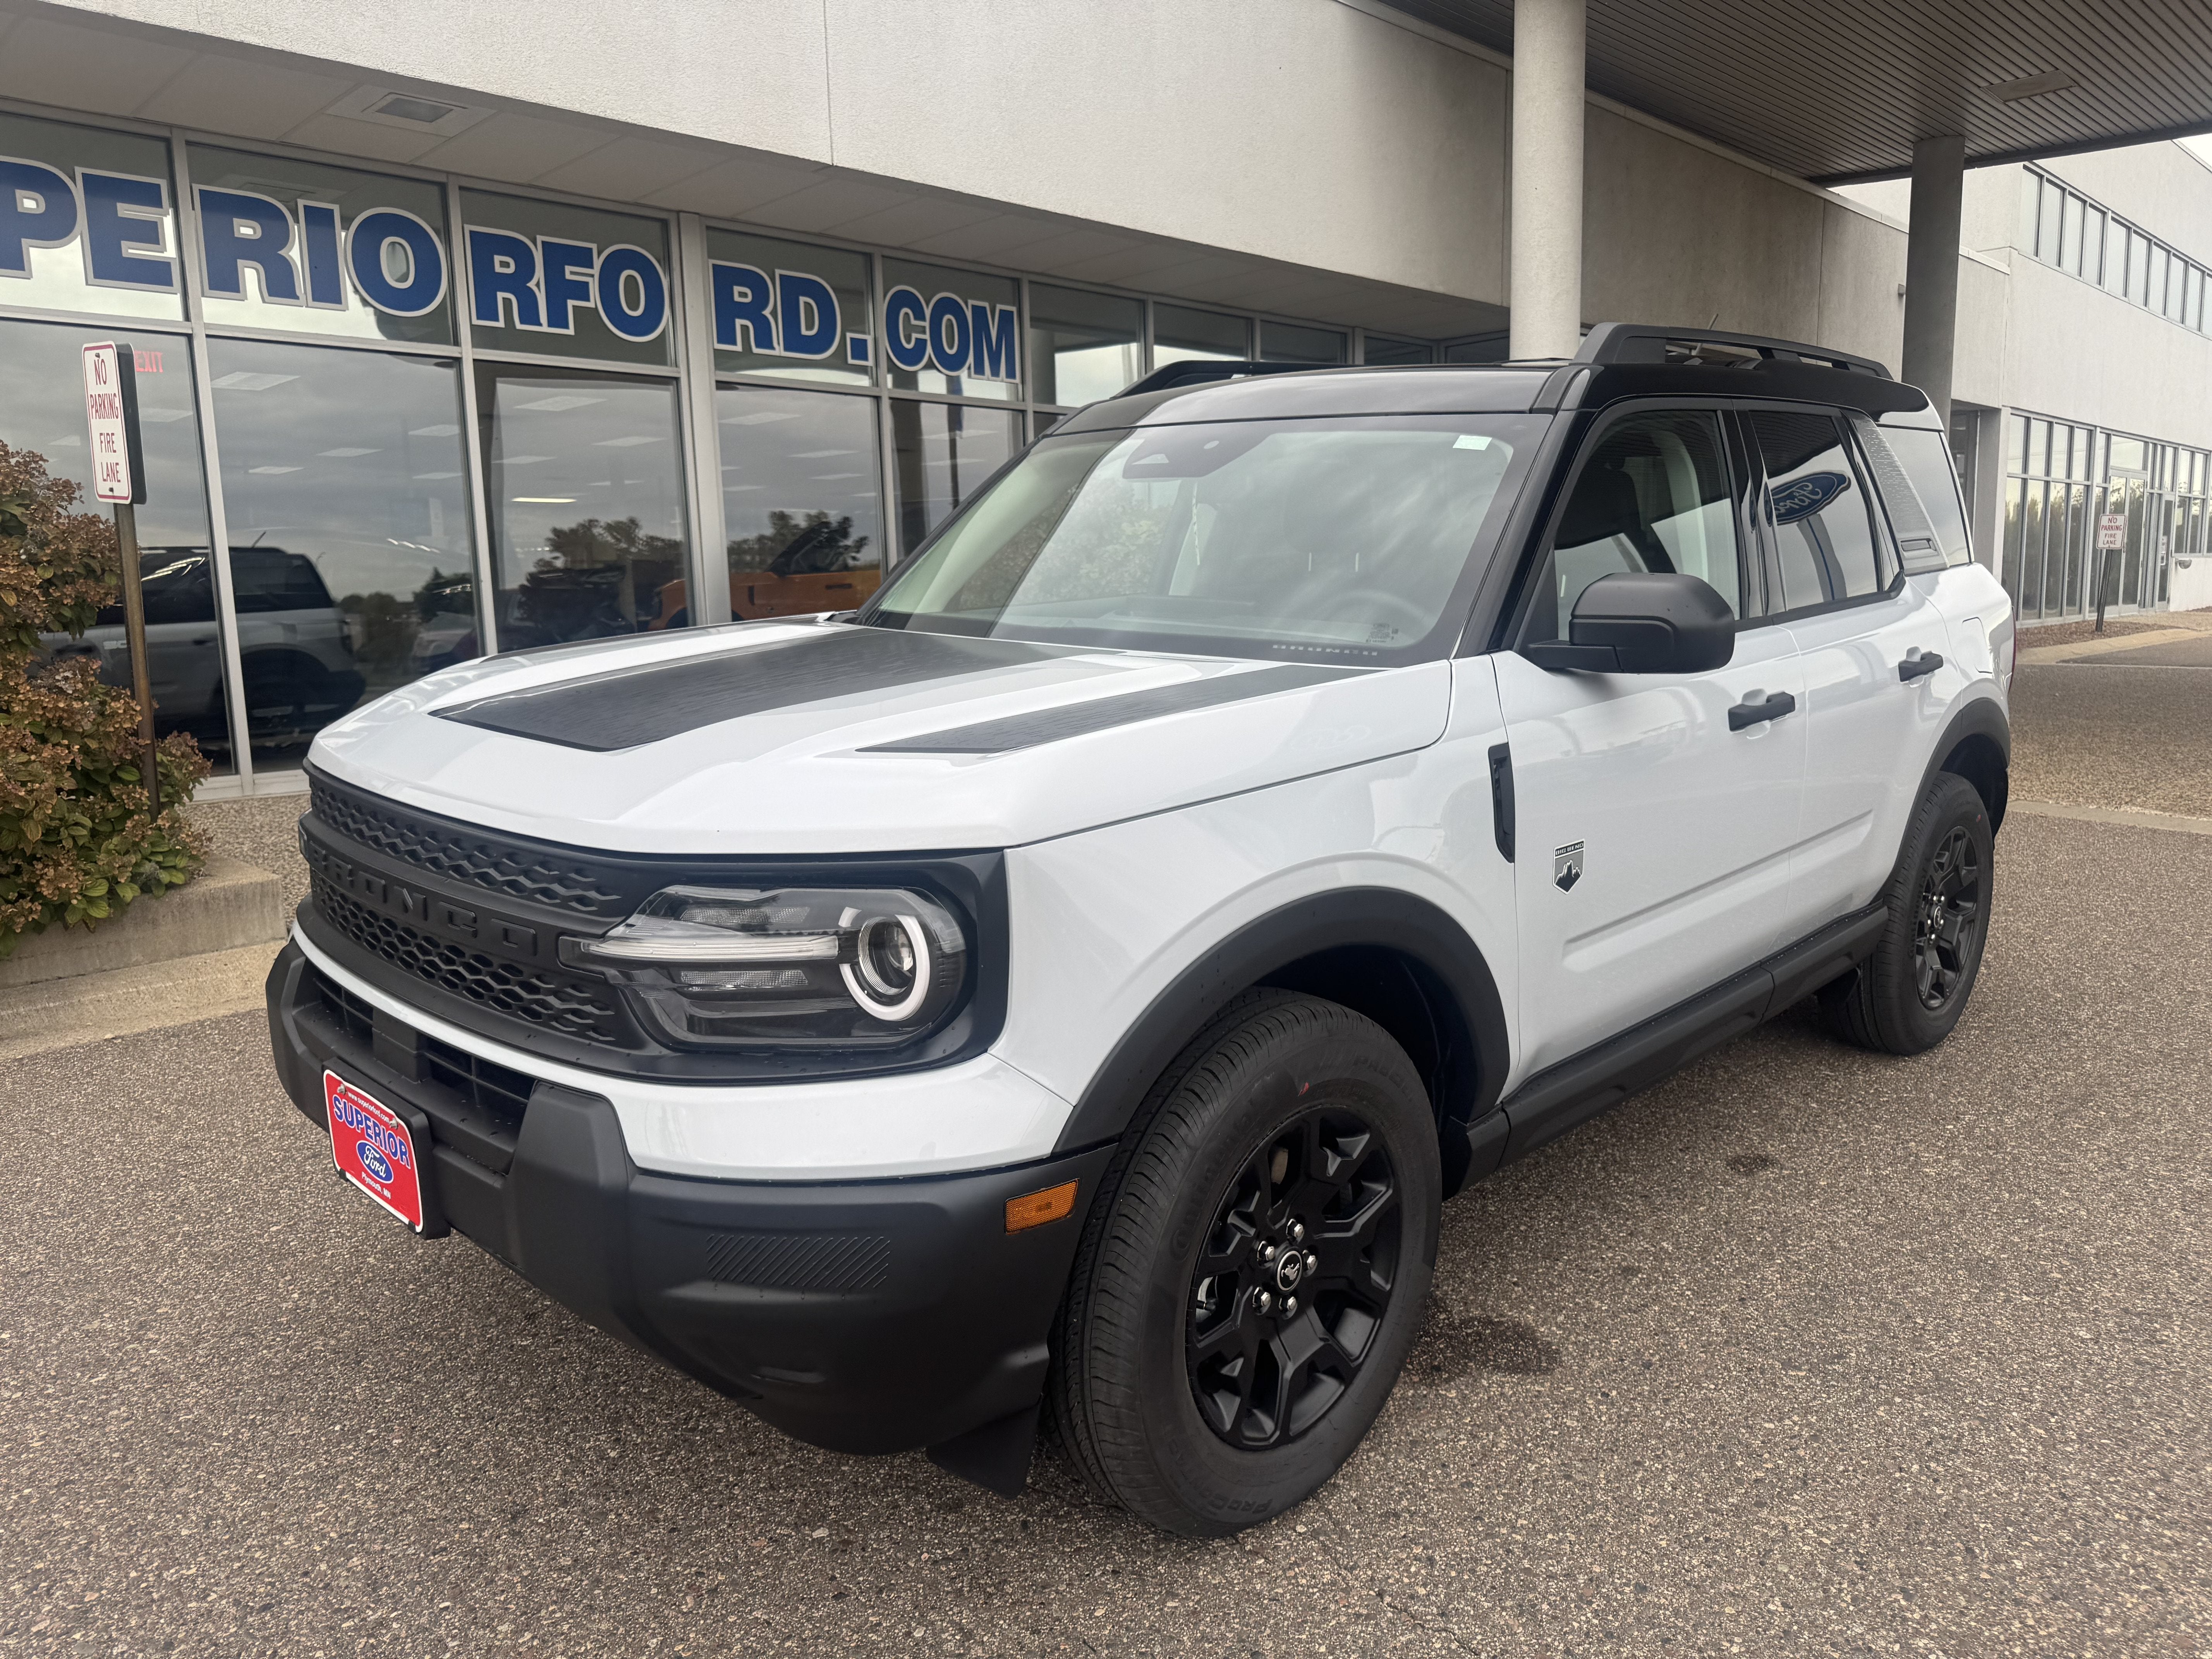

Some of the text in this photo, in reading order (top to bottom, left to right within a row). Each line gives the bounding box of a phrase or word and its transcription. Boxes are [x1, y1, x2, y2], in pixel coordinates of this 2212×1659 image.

[94, 359, 107, 385] NO
[134, 350, 163, 373] EXIT
[89, 393, 119, 420] PARKING
[99, 433, 117, 453] FIRE
[101, 462, 121, 483] LANE
[1567, 843, 1583, 852] BEND
[310, 840, 538, 957] BRONCO
[333, 1094, 411, 1170] SUPERIOR
[364, 1145, 386, 1178] Ford
